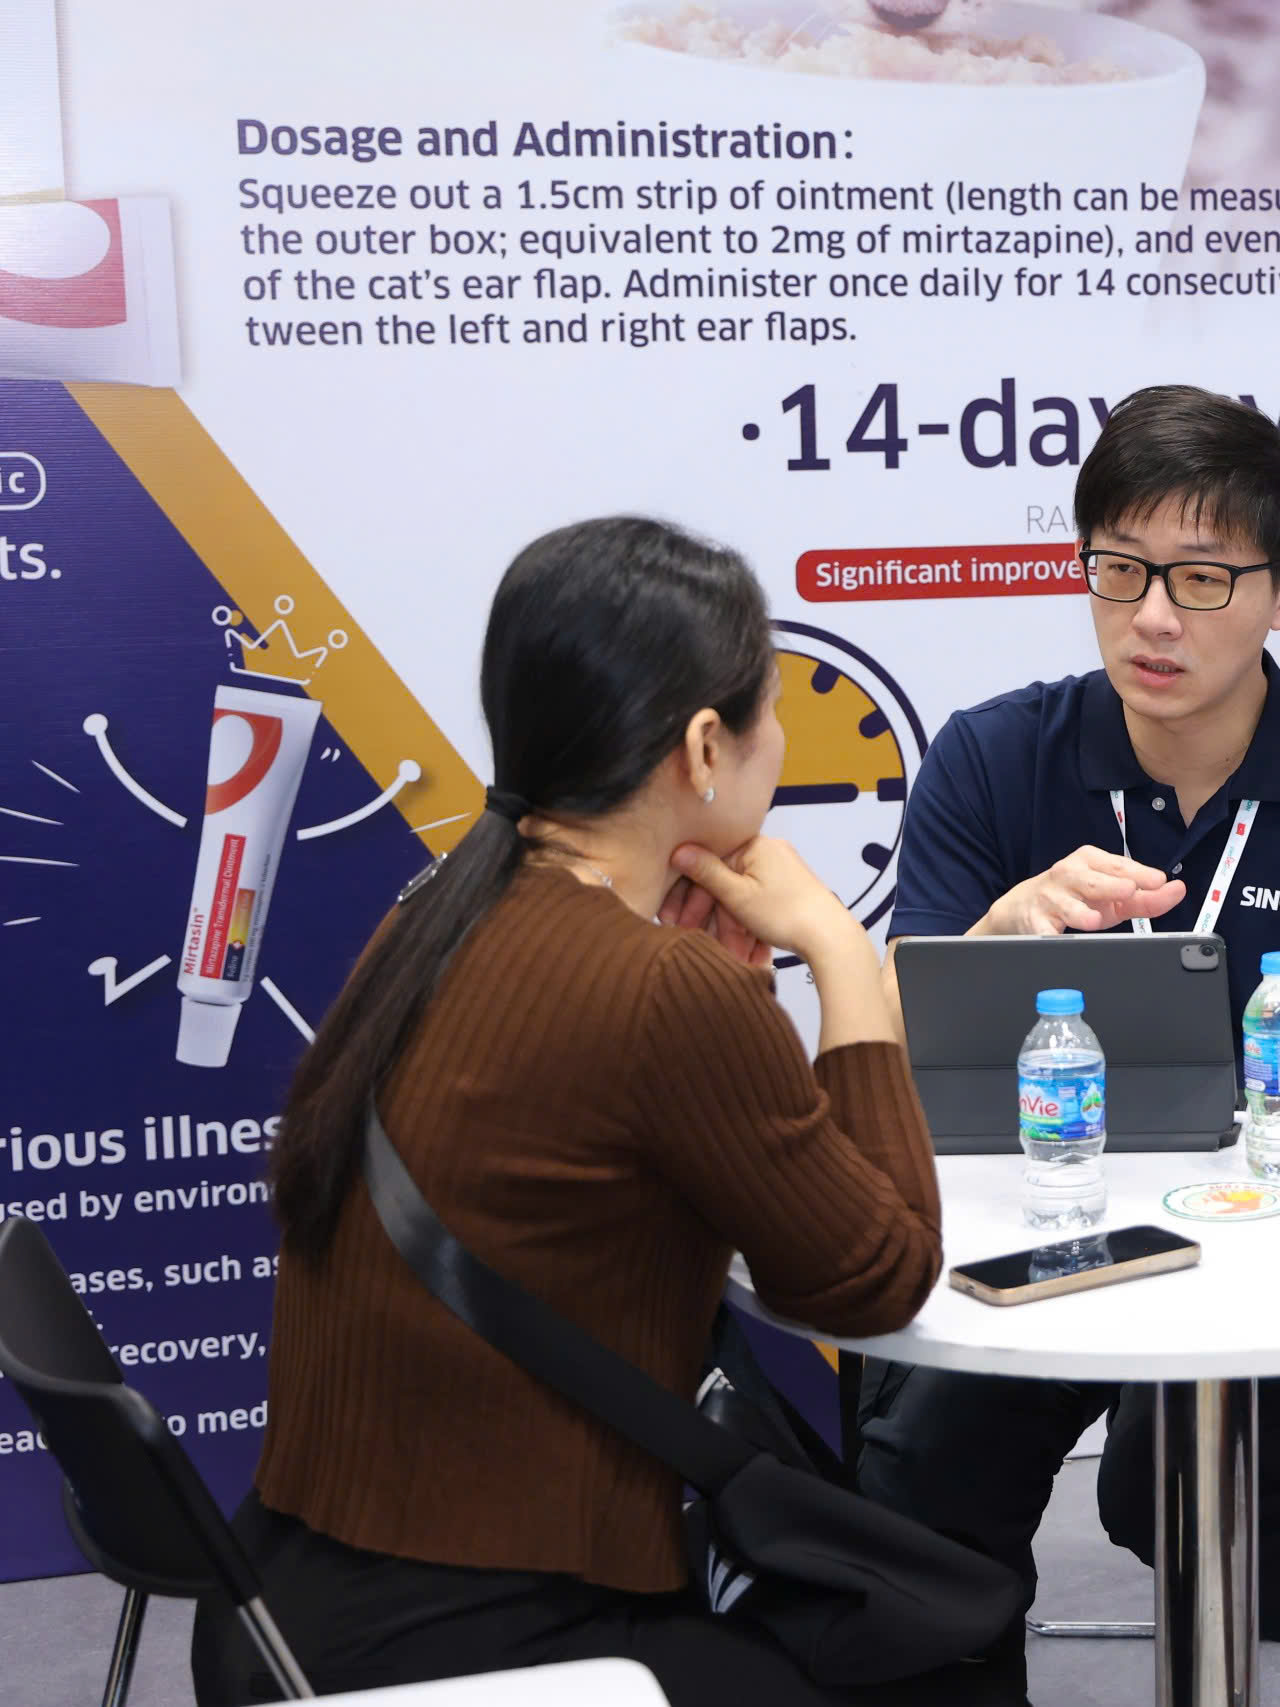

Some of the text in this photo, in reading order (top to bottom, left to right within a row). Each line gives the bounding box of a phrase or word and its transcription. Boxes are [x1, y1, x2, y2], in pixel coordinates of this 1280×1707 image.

[237, 119, 853, 163] Dosage and Administration:
[239, 178, 397, 214] Squeeze
[409, 180, 470, 210] out
[483, 185, 502, 210] a
[518, 180, 624, 210] 1.5cm
[636, 179, 718, 215] strip
[729, 179, 765, 210] of
[776, 179, 934, 211] ointment
[946, 181, 1062, 217] (length
[1073, 188, 1128, 212] can
[1140, 182, 1179, 212] be
[240, 223, 303, 255] the
[316, 225, 416, 255] outer
[429, 223, 507, 259] box;
[519, 223, 712, 260] equivalent
[723, 225, 758, 254] to
[771, 225, 846, 260] 2mg
[856, 223, 891, 254] of
[903, 223, 1124, 259] mirtazapine),
[1135, 224, 1193, 254] and
[244, 269, 282, 301] of
[294, 269, 355, 300] the
[463, 275, 522, 300] ear
[533, 268, 611, 304] flap.
[623, 267, 818, 298] Administer
[829, 273, 908, 298] once
[920, 266, 1003, 302] daily
[1014, 266, 1063, 297] for
[1076, 268, 1116, 296] 14
[245, 311, 856, 348] tween the left and right ear flaps.
[1026, 505, 1080, 535] RA
[816, 558, 962, 589] Significant
[0, 1180, 274, 1224] sed by environ
[164, 1254, 242, 1288] such
[197, 1400, 269, 1435] med
